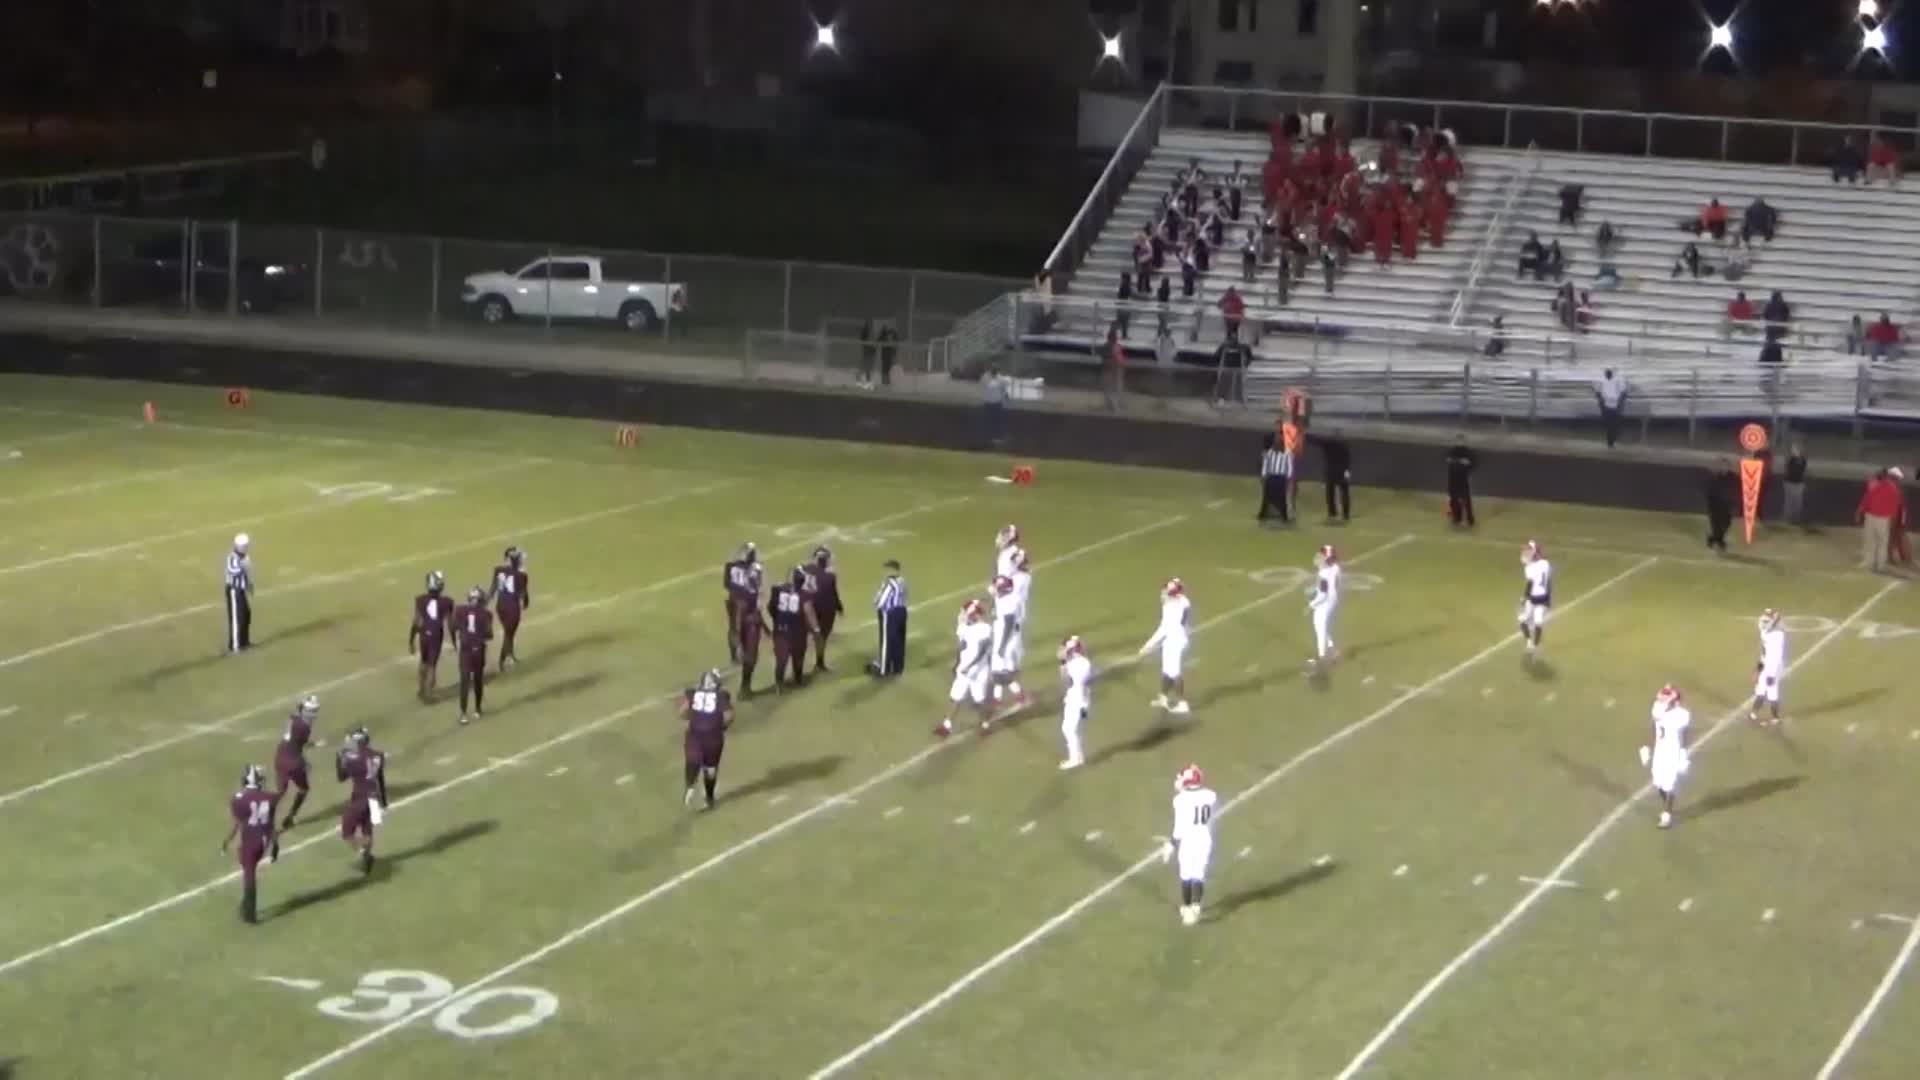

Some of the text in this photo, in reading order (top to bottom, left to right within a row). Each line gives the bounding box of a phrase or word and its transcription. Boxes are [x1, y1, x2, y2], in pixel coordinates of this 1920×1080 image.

[426, 598, 438, 621] 4
[467, 613, 476, 633] 1
[692, 691, 717, 714] 55
[1191, 803, 1209, 825] 10
[317, 968, 559, 1038] 30
